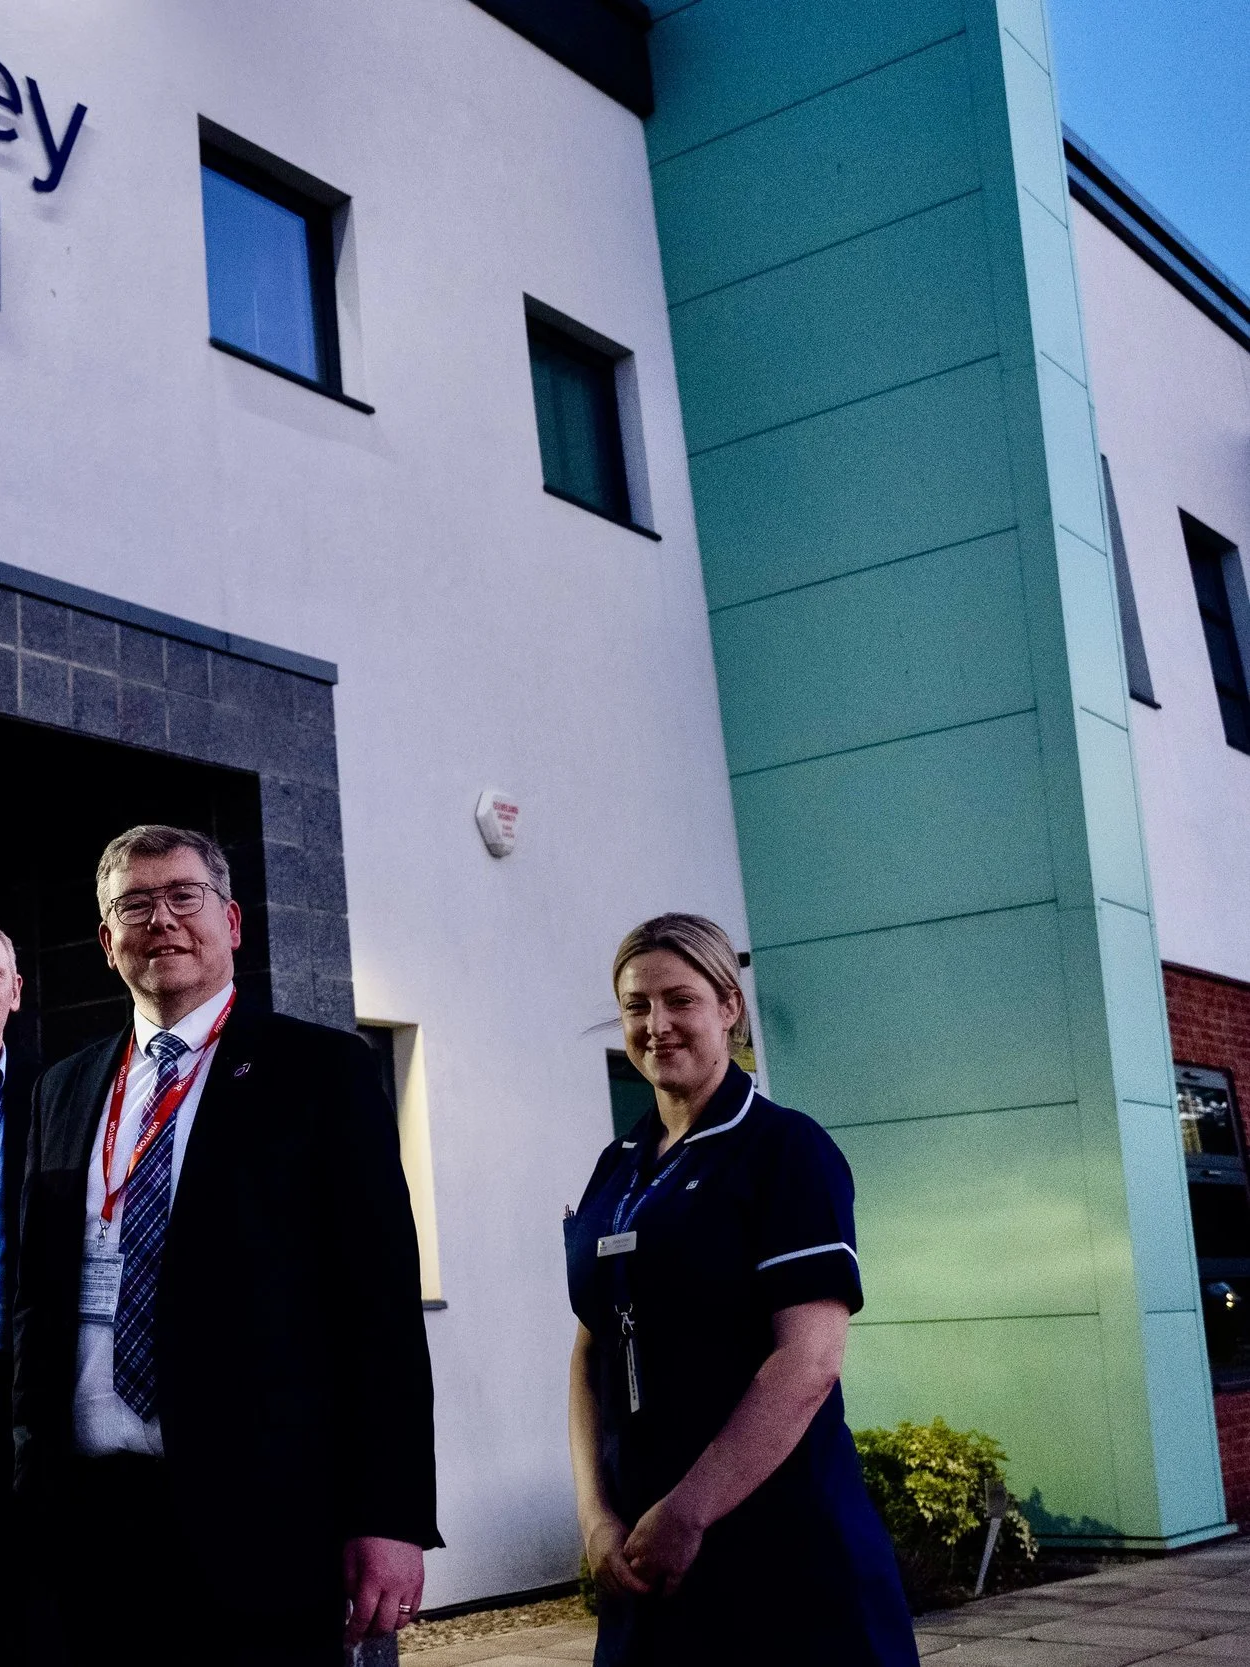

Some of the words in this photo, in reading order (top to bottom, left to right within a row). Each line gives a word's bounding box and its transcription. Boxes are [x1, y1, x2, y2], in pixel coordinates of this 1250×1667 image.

[116, 1064, 127, 1094] VISITOR
[106, 1120, 117, 1152] VISITOR
[136, 1121, 160, 1153] VISITOR
